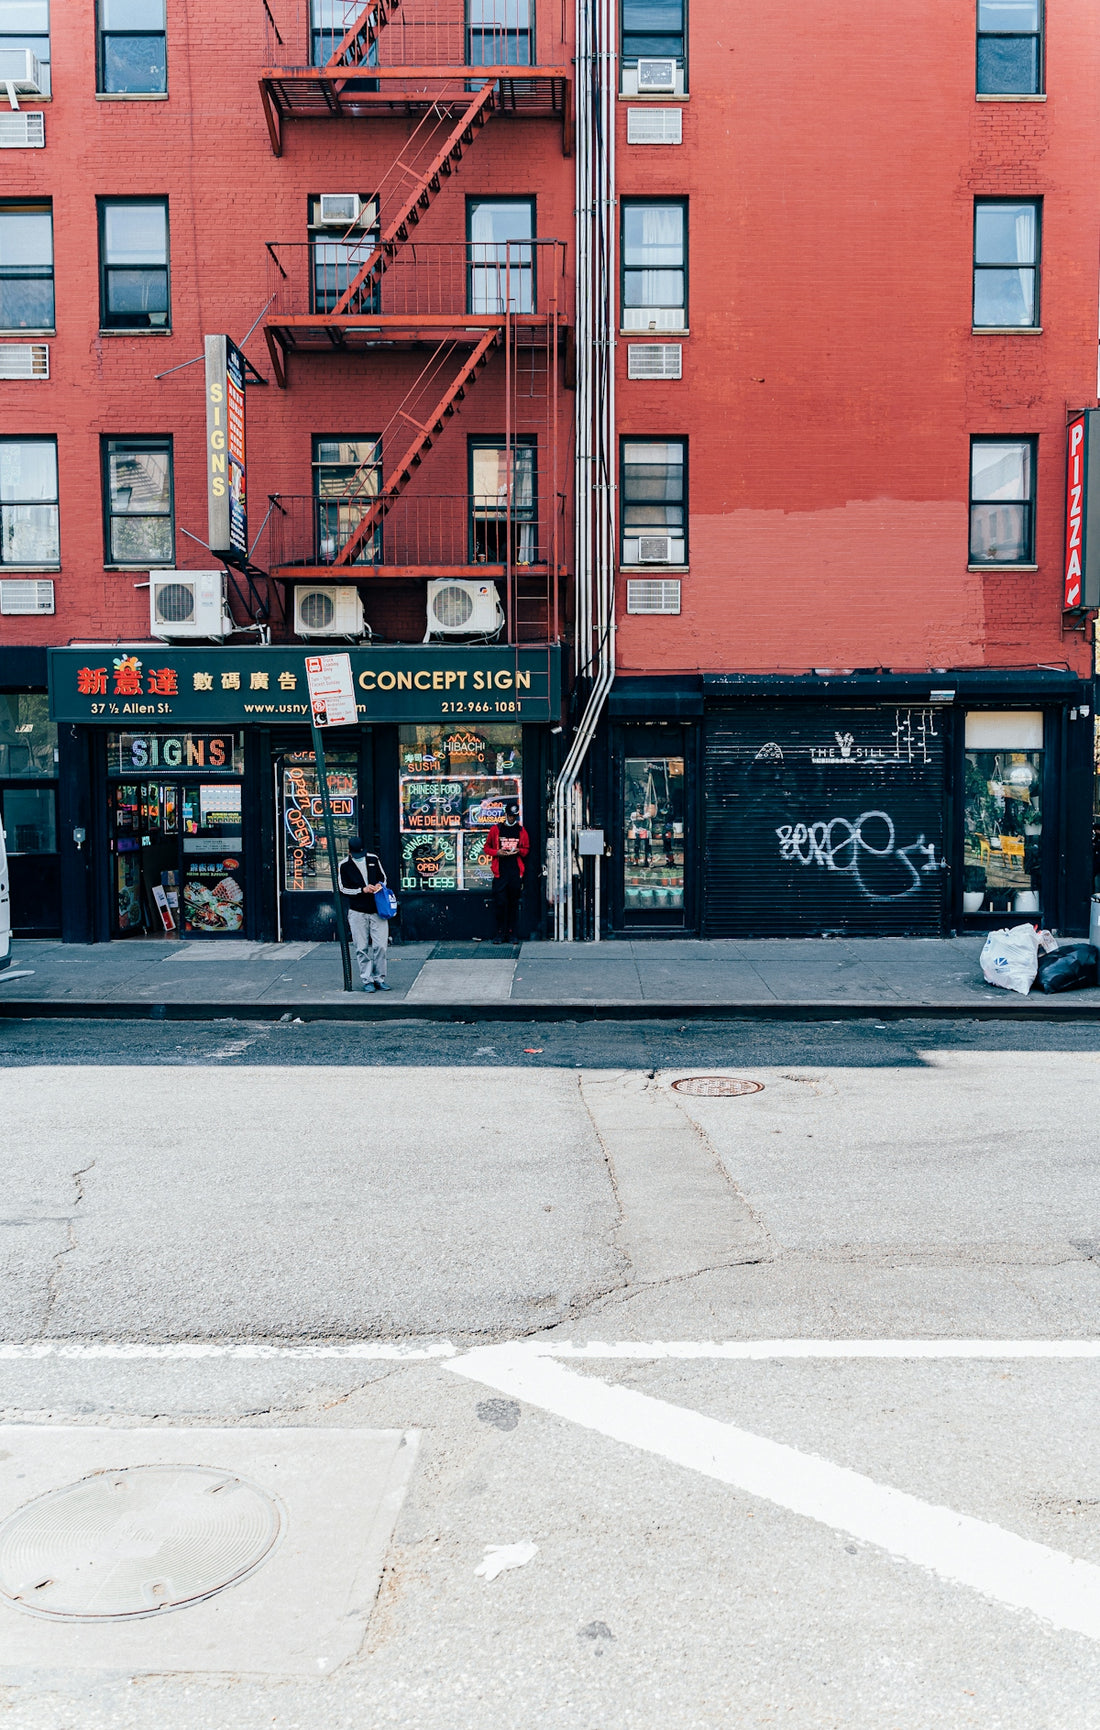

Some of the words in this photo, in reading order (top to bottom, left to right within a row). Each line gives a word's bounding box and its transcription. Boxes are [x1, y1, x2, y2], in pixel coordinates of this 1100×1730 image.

[210, 383, 226, 497] SIGNS
[1066, 424, 1083, 580] PIZZA
[77, 666, 179, 696] 新意達
[192, 671, 298, 691] 數碼廣告
[358, 670, 468, 691] CONCEPT
[472, 670, 531, 690] SIGN
[90, 703, 106, 714] 37
[122, 702, 156, 714] Allen
[157, 703, 173, 714] St.
[131, 739, 226, 767] SIGNS
[443, 741, 486, 752] HIBACHI
[809, 748, 835, 757] THE
[856, 748, 885, 757] SILL
[408, 761, 441, 773] SUSHI
[407, 784, 439, 795] CHINESE
[440, 784, 461, 795] FOOD
[288, 809, 312, 848] OPEN
[408, 815, 423, 826] WE
[424, 815, 461, 826] DELIVER
[402, 834, 434, 860] CHINESE
[438, 837, 455, 861] FOOD
[416, 863, 439, 872] OPEN
[478, 854, 493, 866] OP
[293, 848, 304, 890] OPEN
